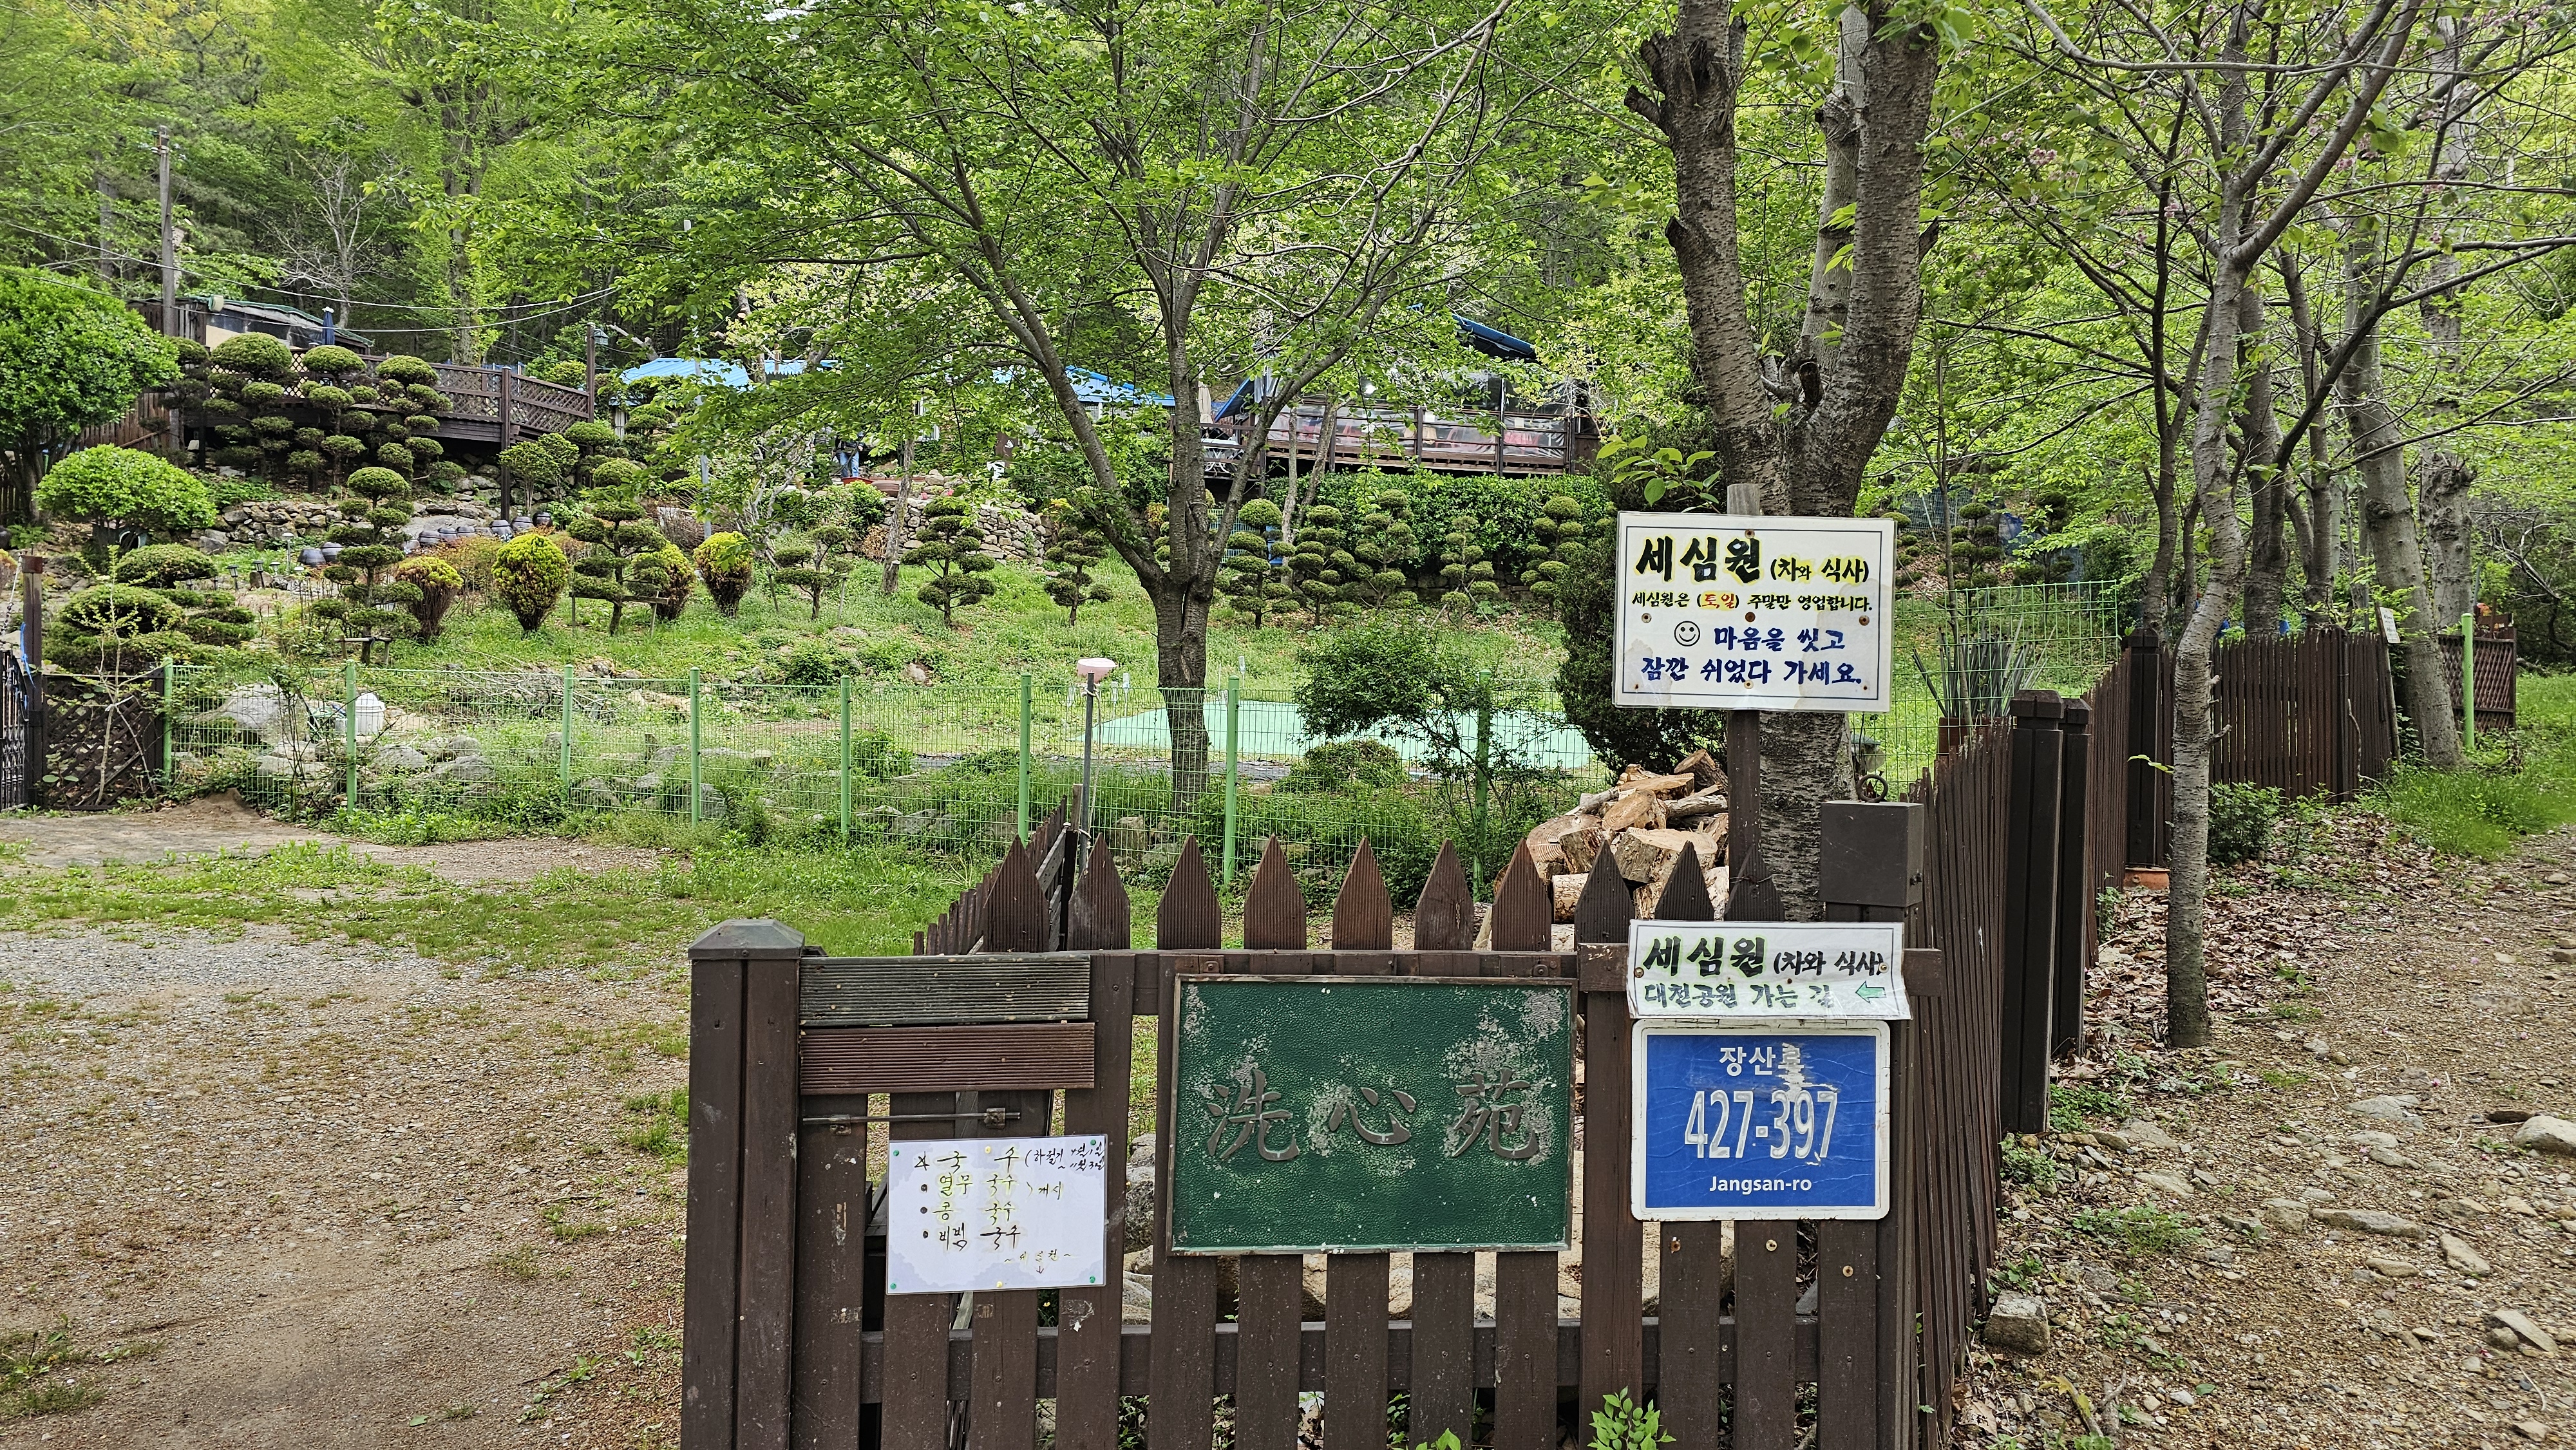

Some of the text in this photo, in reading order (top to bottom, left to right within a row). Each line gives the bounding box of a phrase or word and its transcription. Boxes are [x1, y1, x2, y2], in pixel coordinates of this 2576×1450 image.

[1635, 535, 1870, 583] 세심원 (차와 식사)
[1632, 592, 1873, 612] 세심원은 (토,일) 주말만 영업합니다.
[1714, 626, 1845, 652] 마음을 씻고
[1641, 656, 1862, 685] 잠깐 쉬었다 가세요.
[1642, 936, 1884, 977] 세심원 (차와 식사)
[1644, 983, 1738, 1008] 대천공원
[1750, 984, 1798, 1008] 가는
[1719, 1046, 1804, 1077] 장산로
[1684, 1089, 1837, 1159] 427-397
[940, 1171, 973, 1197] 열무
[986, 1174, 1018, 1197] 국수
[1709, 1176, 1812, 1195] Jangsan-ro
[932, 1201, 1016, 1226] 콩 국수
[939, 1222, 1021, 1252] 비빔 국수
